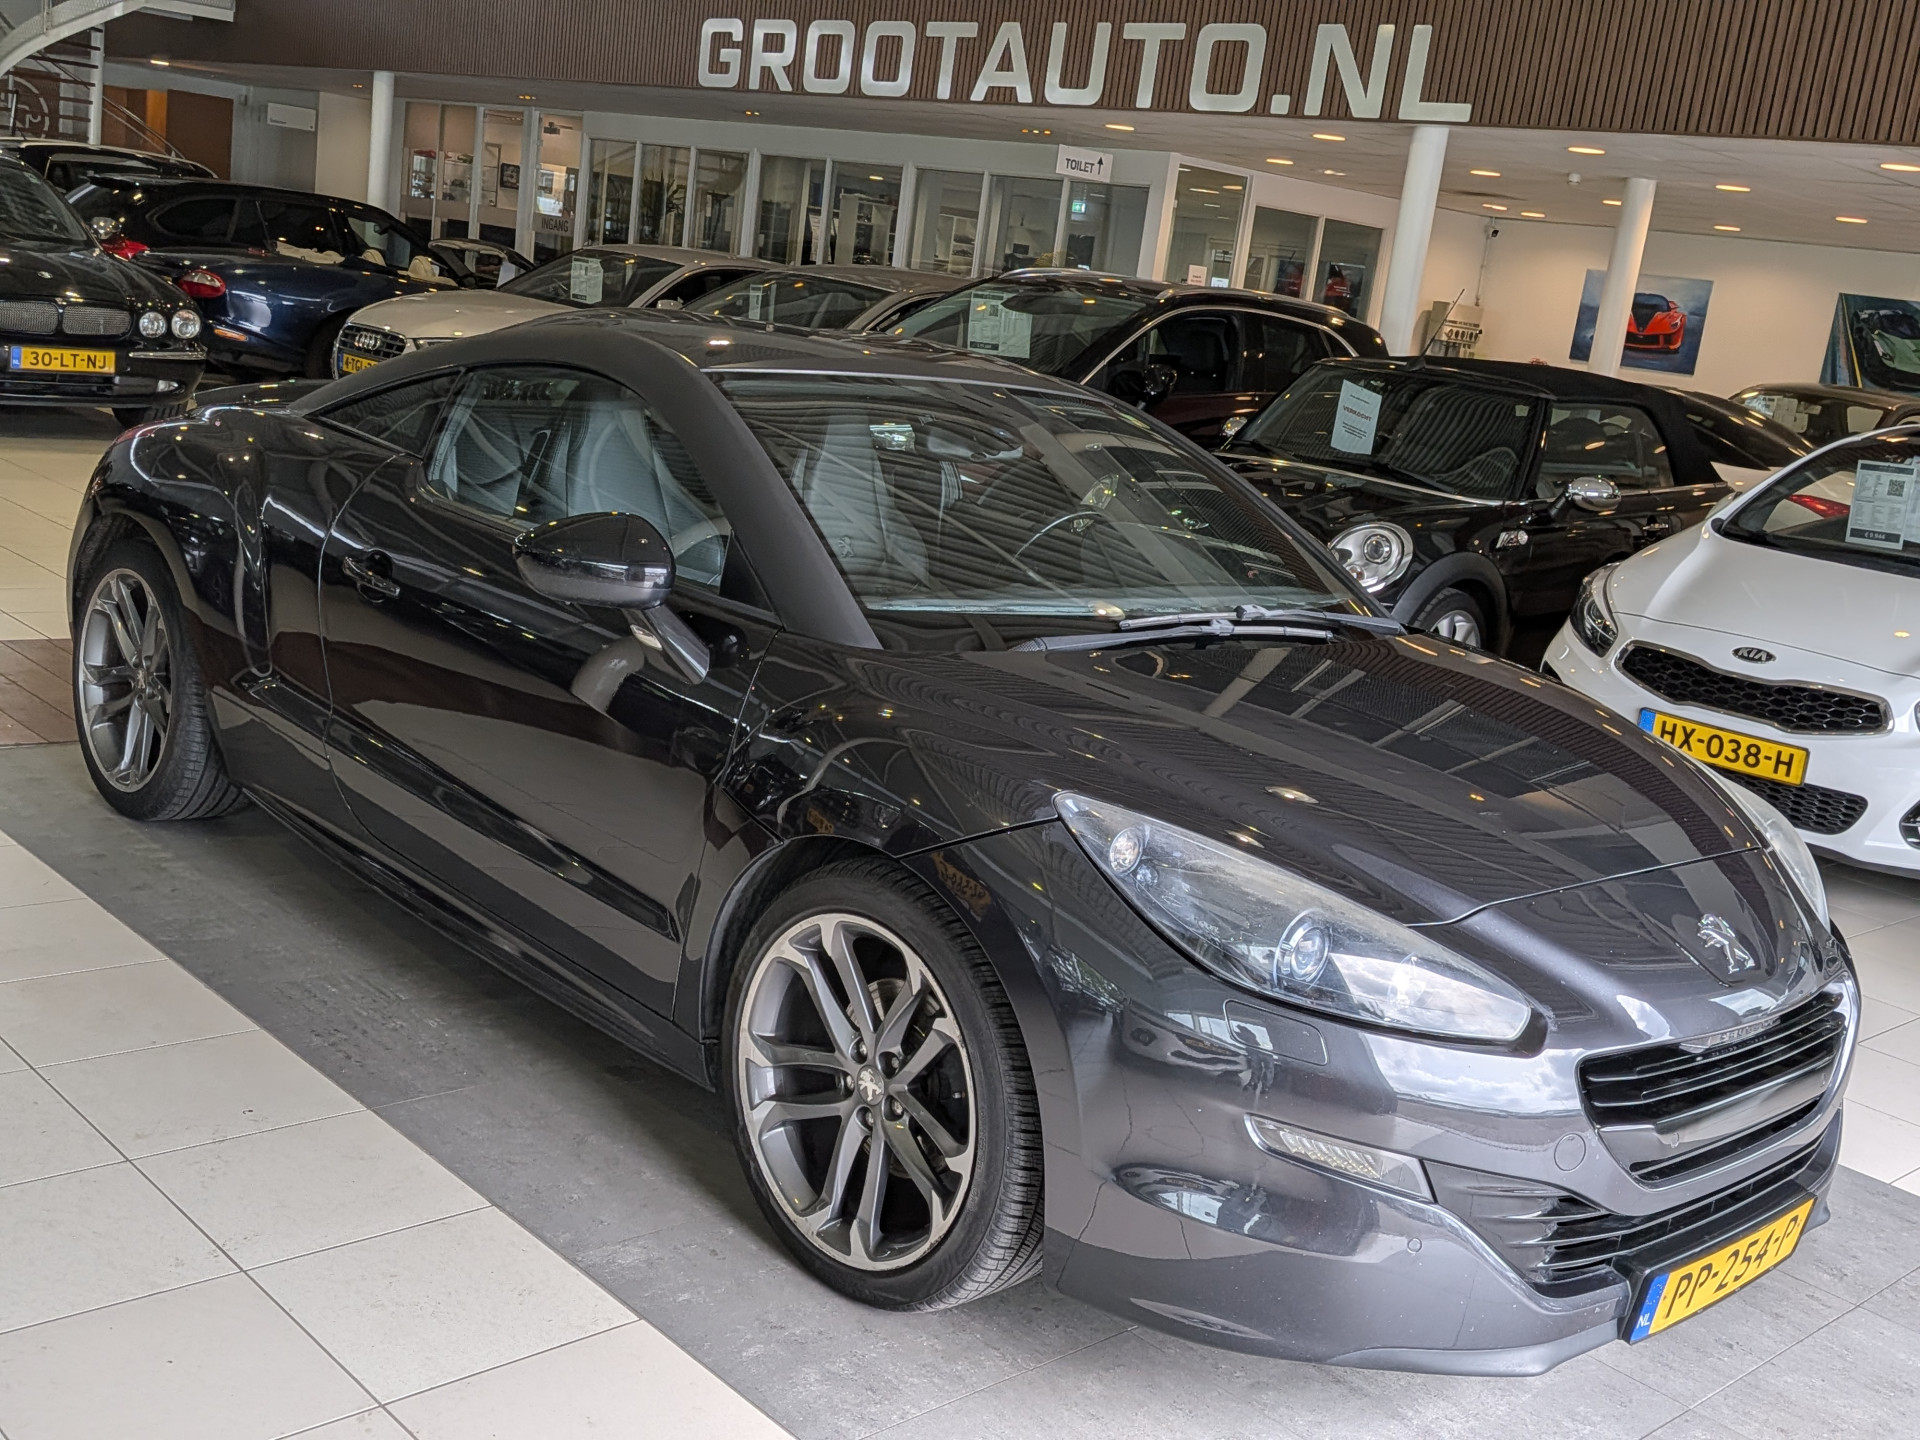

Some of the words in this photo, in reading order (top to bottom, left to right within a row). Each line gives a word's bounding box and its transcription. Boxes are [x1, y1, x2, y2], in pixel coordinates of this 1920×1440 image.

[698, 18, 1472, 122] GROOTAUTO.NL
[1065, 157, 1095, 174] TOILET
[541, 217, 569, 232] INGANG
[29, 351, 107, 369] 30-LT-NJ
[1343, 405, 1372, 422] VERKOCHT
[1737, 647, 1768, 661] KIA
[1660, 720, 1794, 777] HX-038-H
[1664, 1214, 1799, 1319] PP-254-P
[1636, 1312, 1650, 1329] NL
